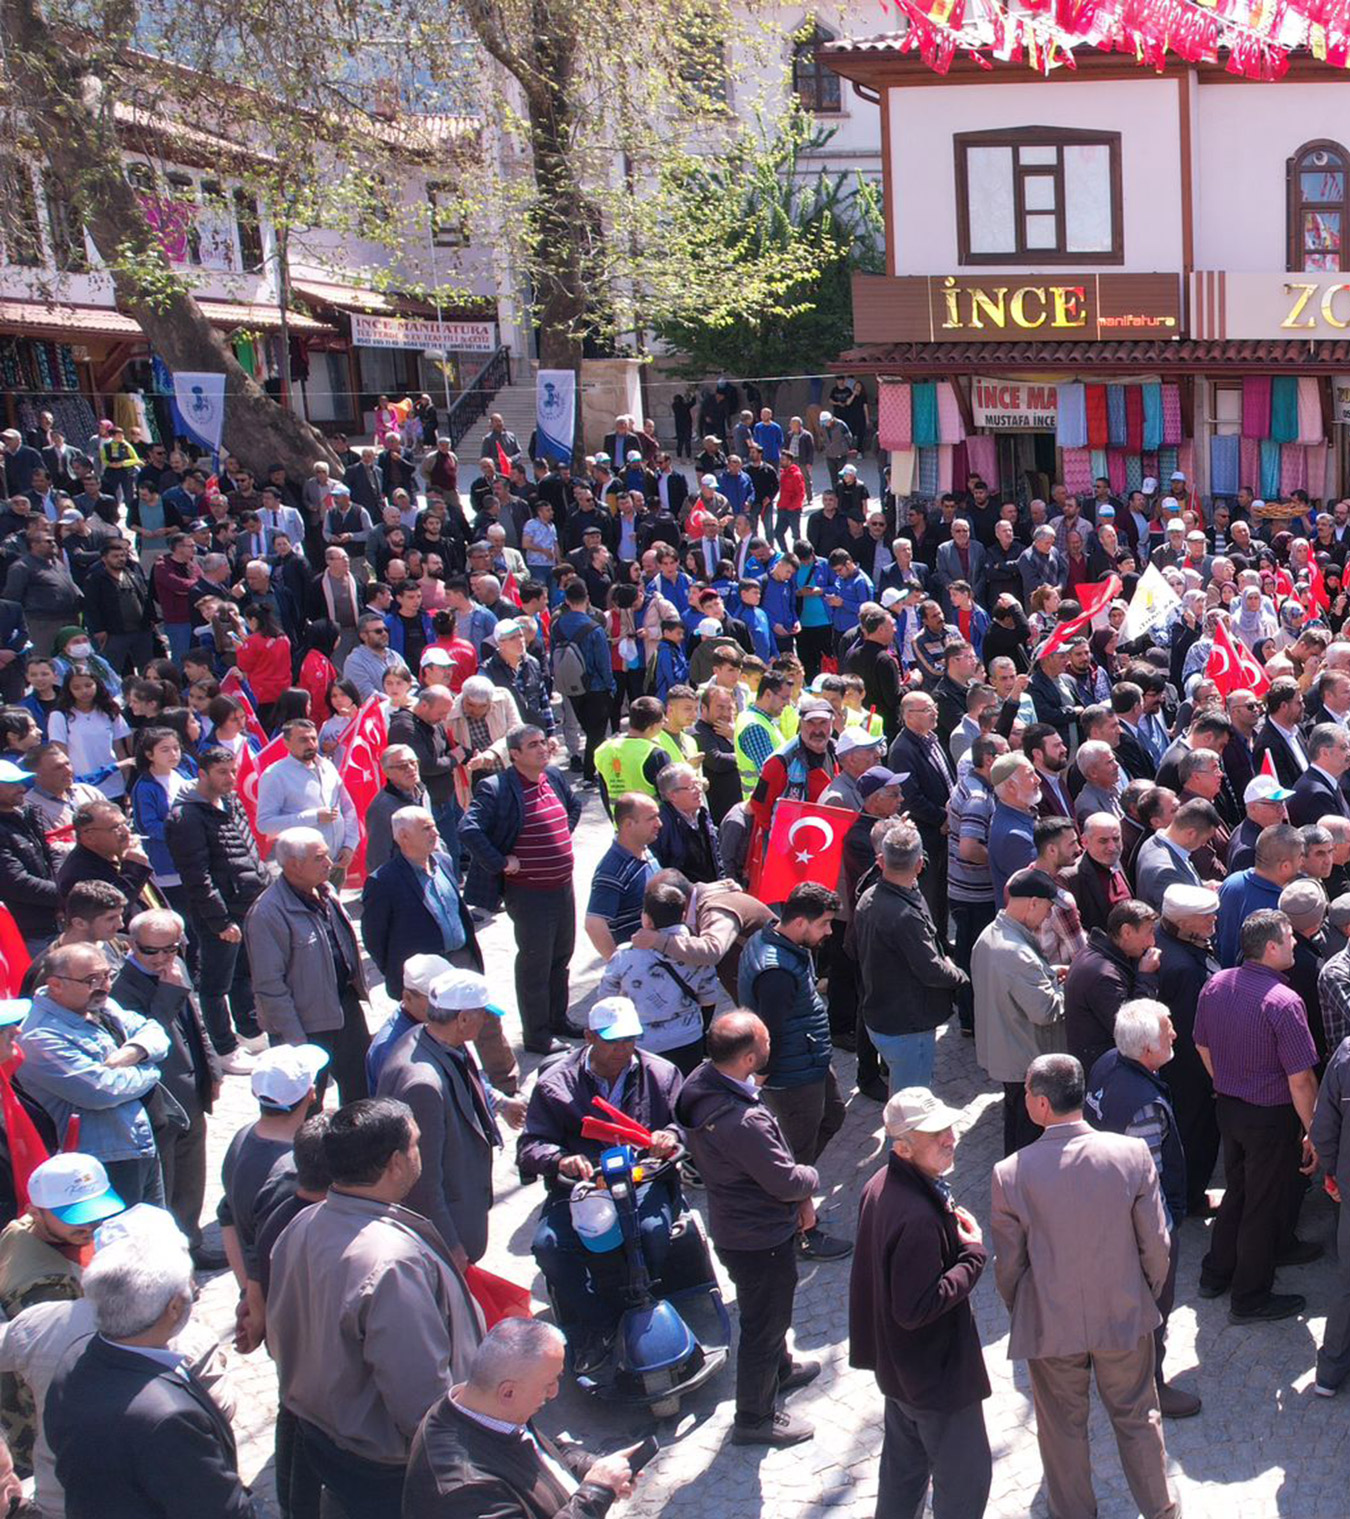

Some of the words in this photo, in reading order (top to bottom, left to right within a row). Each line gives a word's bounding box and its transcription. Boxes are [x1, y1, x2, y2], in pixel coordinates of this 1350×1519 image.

[940, 276, 1086, 328] İNCE
[1097, 315, 1175, 326] manifatura
[976, 379, 1020, 409] İNCE
[985, 415, 1030, 426] MUSTAFA
[1033, 412, 1055, 426] İNCE
